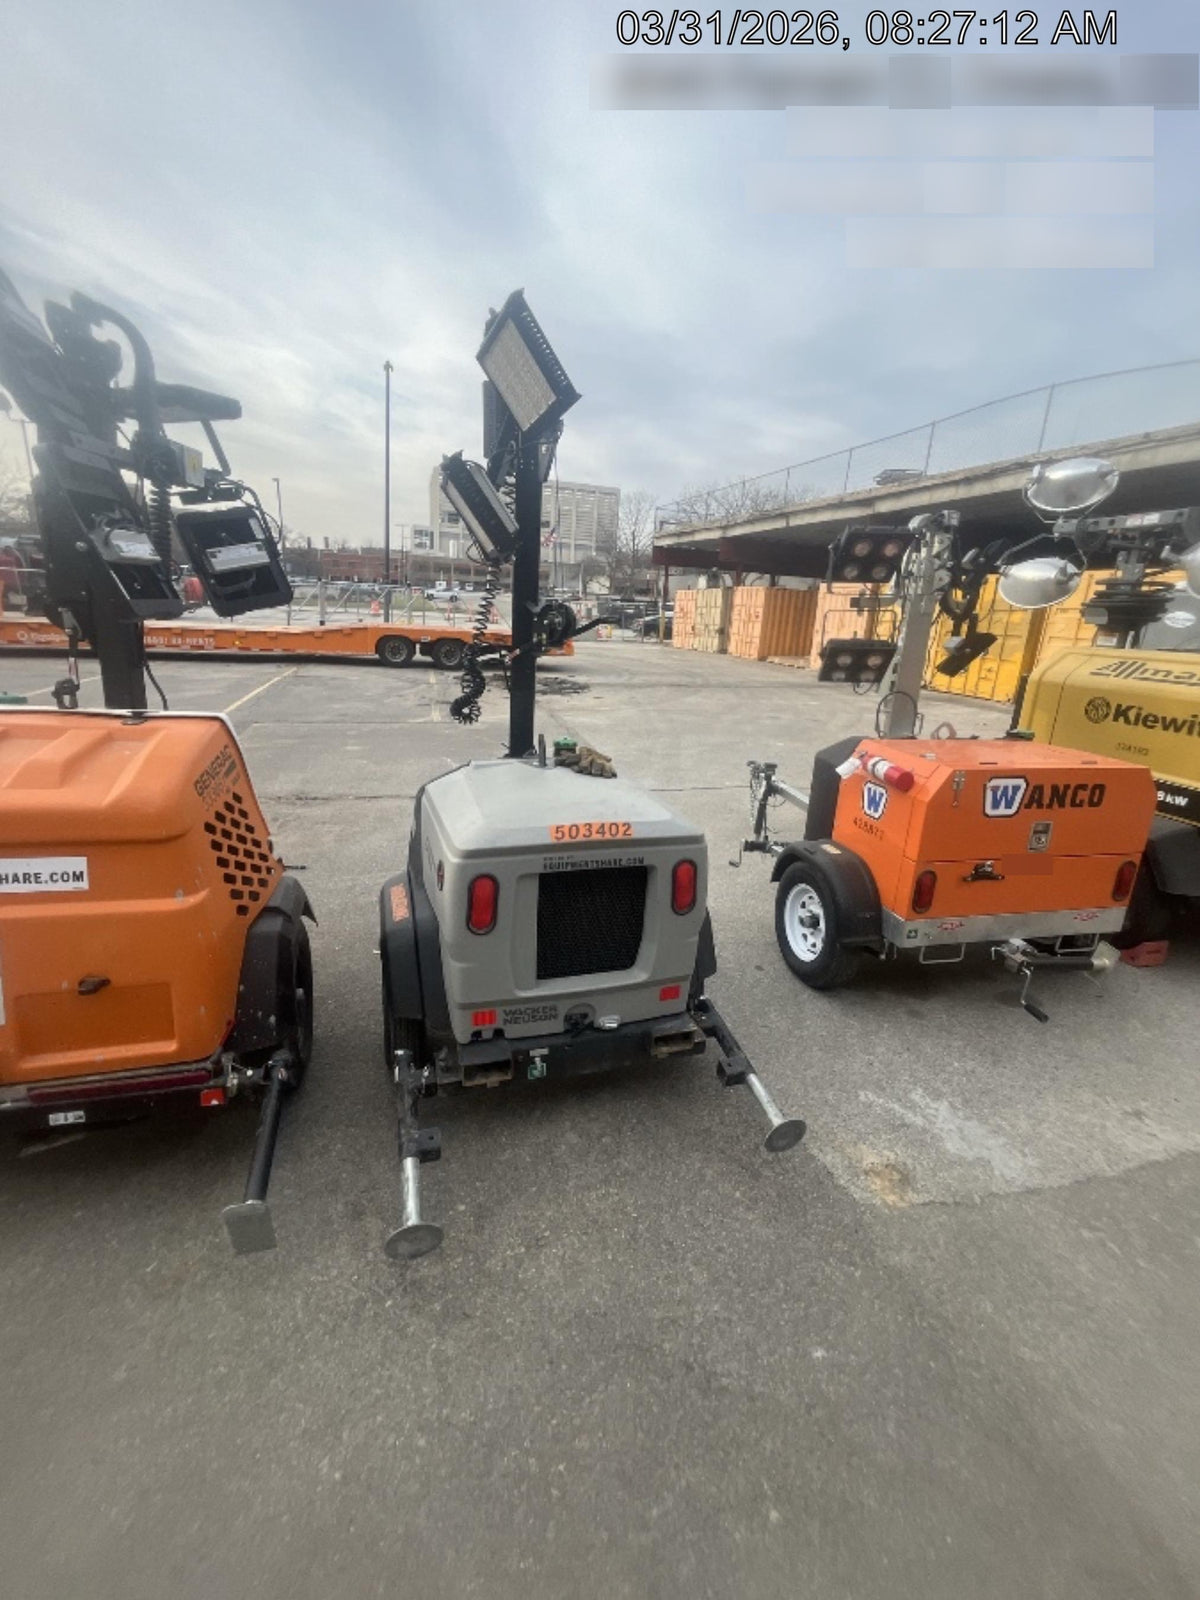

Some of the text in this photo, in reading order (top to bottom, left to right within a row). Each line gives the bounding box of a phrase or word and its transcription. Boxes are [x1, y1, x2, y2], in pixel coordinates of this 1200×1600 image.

[1093, 659, 1200, 683] Allma
[989, 783, 1106, 810] WANCO
[554, 822, 632, 840] 503402
[503, 1004, 558, 1017] WACKER
[503, 1012, 558, 1026] NEUSON
